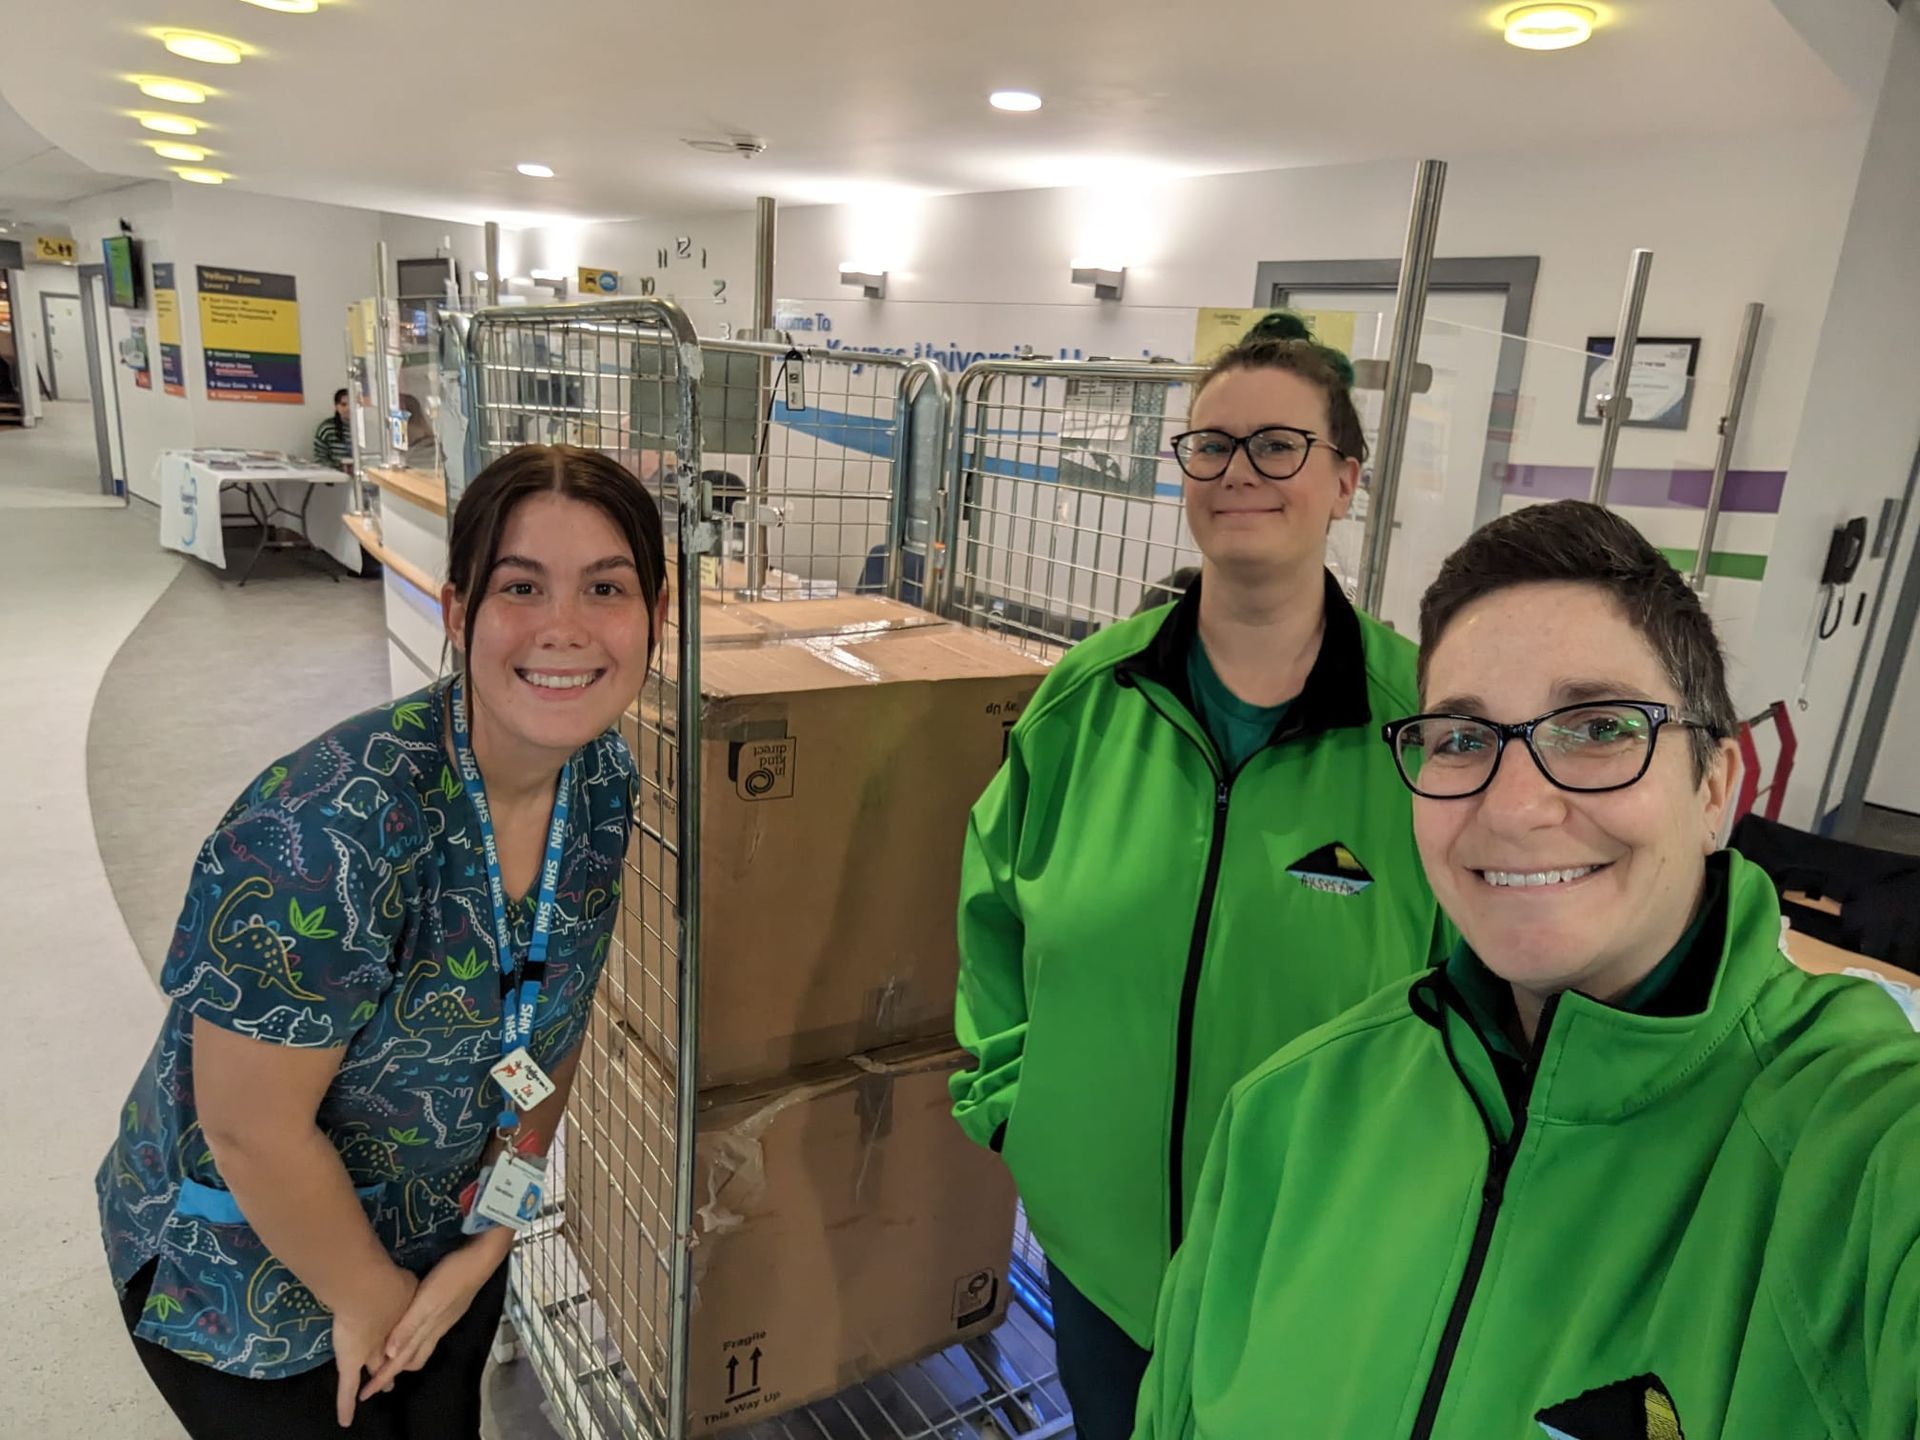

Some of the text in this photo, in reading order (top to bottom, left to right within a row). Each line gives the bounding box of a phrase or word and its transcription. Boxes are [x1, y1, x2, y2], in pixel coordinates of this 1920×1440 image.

[657, 248, 668, 269] 11
[640, 276, 656, 297] 10
[816, 312, 831, 331] To
[452, 699, 469, 734] NHS
[985, 702, 1001, 715] Up
[458, 747, 480, 781] NHS
[753, 744, 787, 757] direct
[760, 756, 786, 769] kind
[776, 767, 786, 778] in
[472, 791, 491, 824] NHS
[558, 777, 569, 807] NHS
[550, 818, 565, 849] NHS
[485, 834, 498, 866] NHS
[544, 859, 558, 891] NHS
[492, 876, 504, 908] NHS
[497, 917, 509, 948] NHS
[537, 901, 551, 933] NHS
[504, 1013, 518, 1044] NHS
[518, 1003, 534, 1034] NHS
[722, 1330, 767, 1352] Fragile
[704, 1390, 781, 1425] This Way Up
